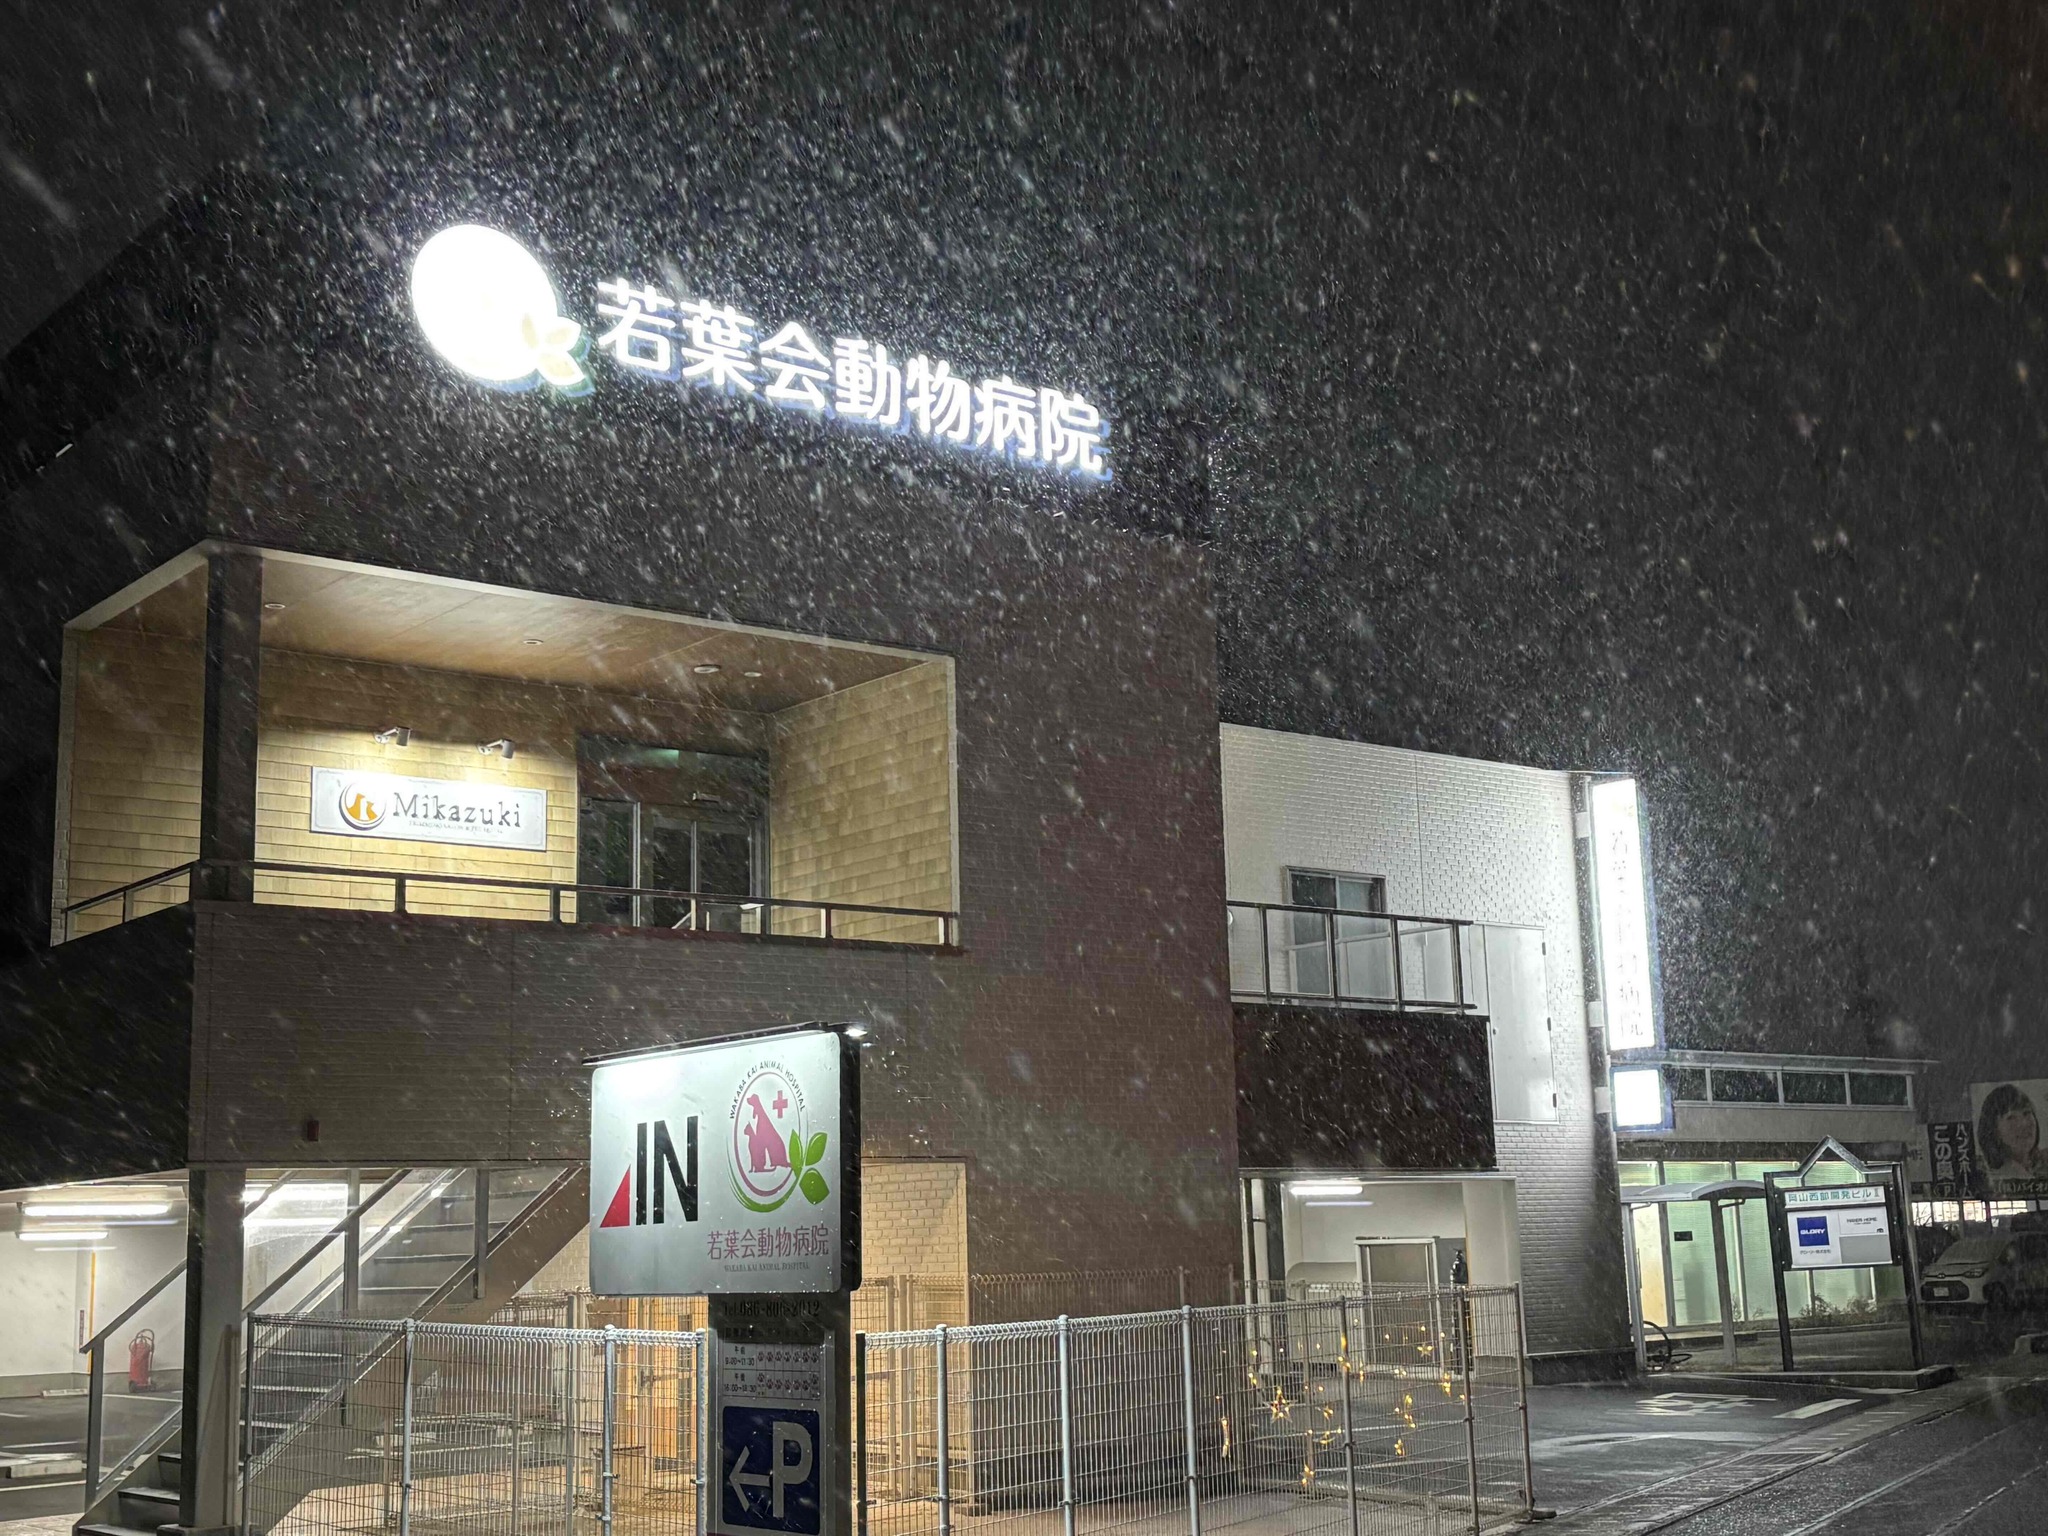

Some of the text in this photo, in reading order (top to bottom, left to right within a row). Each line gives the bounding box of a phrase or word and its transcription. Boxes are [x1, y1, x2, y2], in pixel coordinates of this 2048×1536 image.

[598, 277, 1106, 475] 若葉会動物病院
[393, 791, 522, 828] Mikazuki
[729, 1079, 747, 1119] WAKABA
[759, 1060, 785, 1073] ANIMAL
[784, 1068, 806, 1112] HOSPITAL
[636, 1115, 699, 1226] IN
[707, 1223, 830, 1260] 若葉会動物病院
[773, 1421, 813, 1518] P
